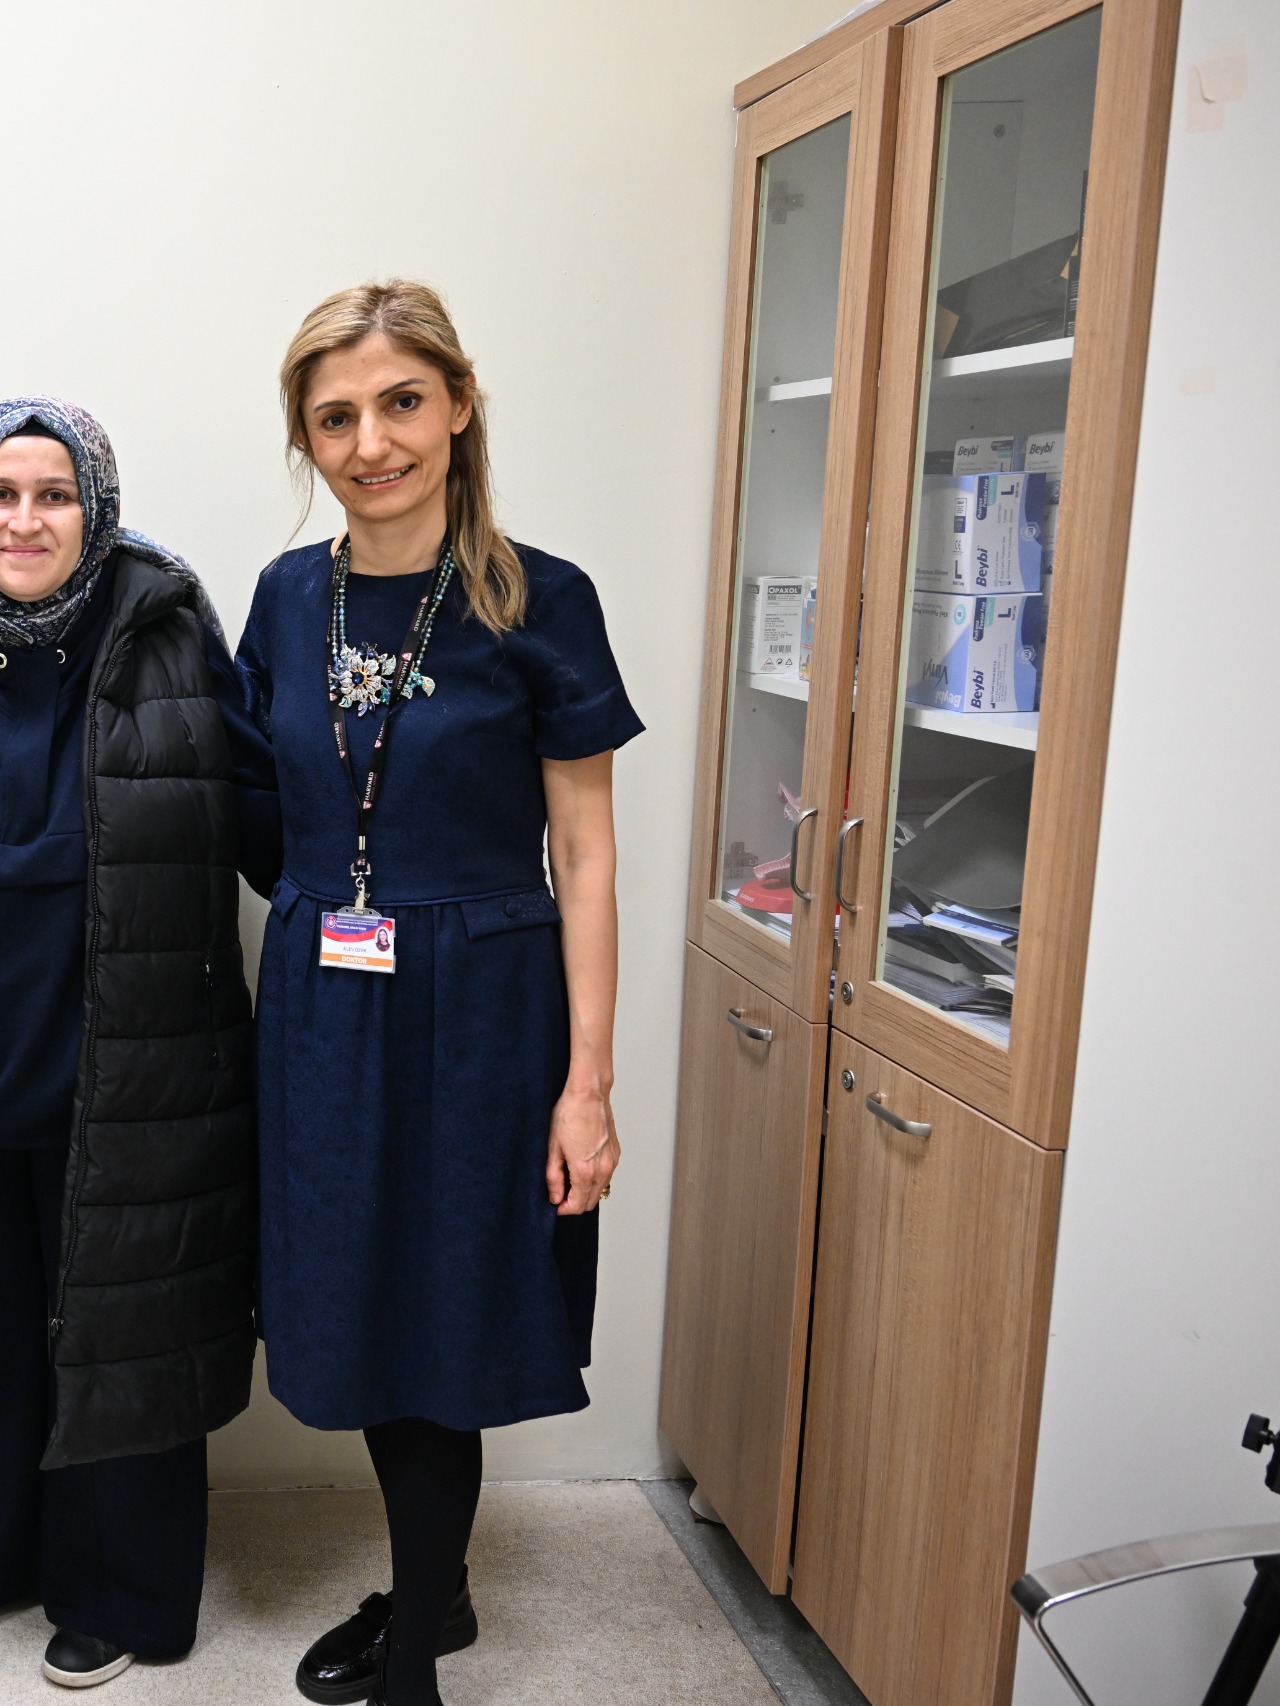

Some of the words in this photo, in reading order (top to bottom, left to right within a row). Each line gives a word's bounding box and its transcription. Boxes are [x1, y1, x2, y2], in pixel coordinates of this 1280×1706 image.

[957, 445, 979, 457] Beybi
[1029, 442, 1054, 455] Beybi
[1000, 485, 1014, 496] L
[955, 560, 962, 579] L
[975, 548, 989, 587] Beybi
[413, 604, 425, 632] HARVARD
[998, 607, 1011, 618] L
[396, 660, 409, 690] HARVARD
[922, 658, 949, 688] Vinyl
[935, 690, 961, 708] Beybi
[971, 670, 985, 709] Beybi
[333, 722, 342, 751] HARVARD
[364, 771, 374, 801] HARVARD
[341, 956, 367, 964] DOKTOR
